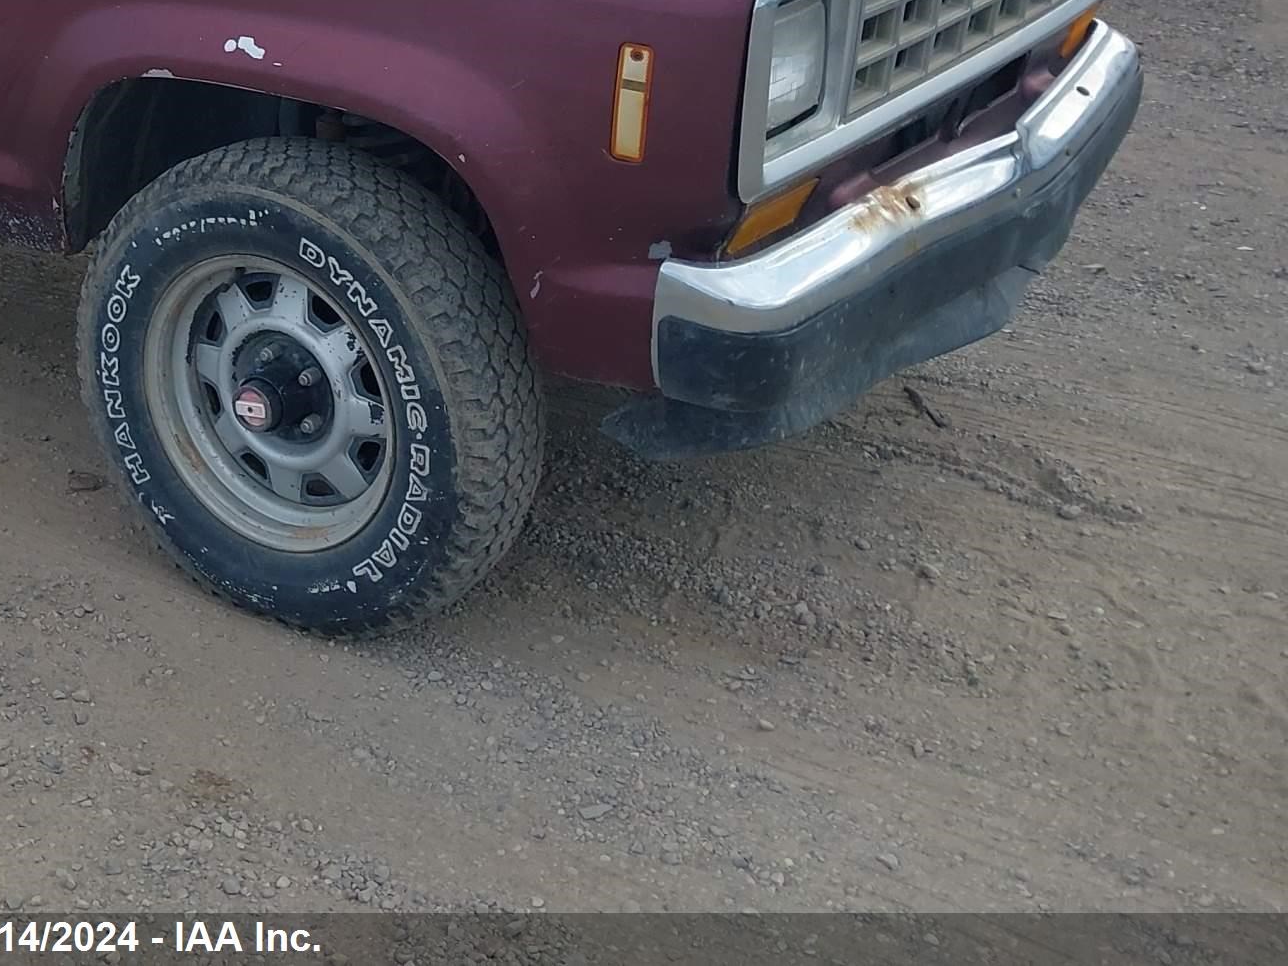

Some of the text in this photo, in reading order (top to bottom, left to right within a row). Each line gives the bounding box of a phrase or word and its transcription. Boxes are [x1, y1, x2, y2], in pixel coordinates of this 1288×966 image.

[101, 264, 151, 485] HANKOOK
[299, 237, 430, 582] DYNAMIC RADIAL
